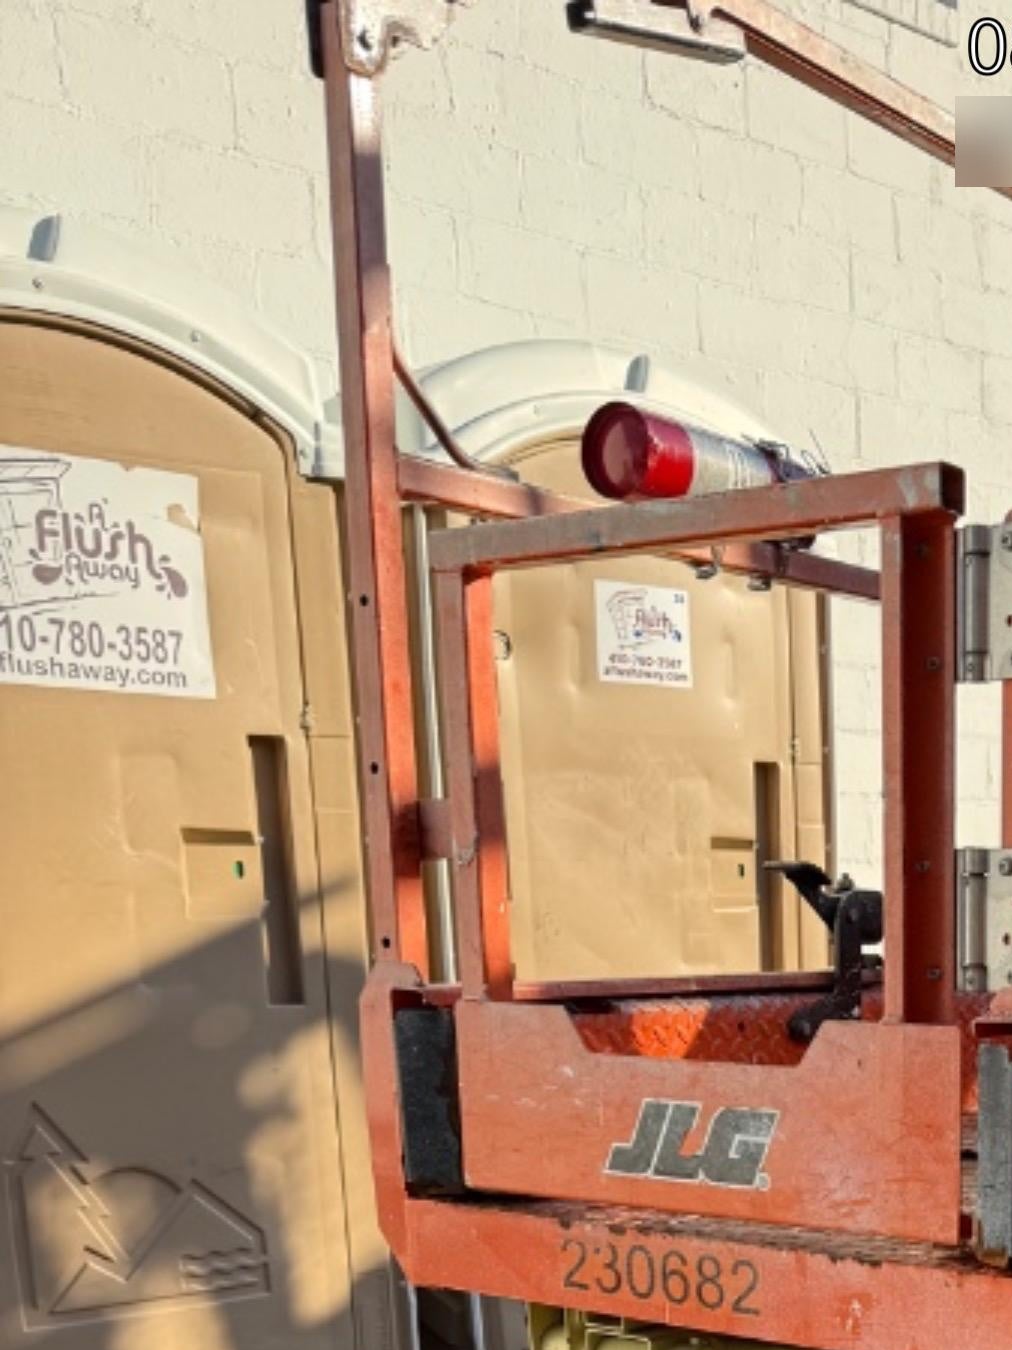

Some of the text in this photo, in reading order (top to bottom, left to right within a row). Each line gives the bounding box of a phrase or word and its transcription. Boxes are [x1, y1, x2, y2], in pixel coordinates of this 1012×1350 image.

[35, 509, 162, 580] Flush
[65, 552, 140, 588] Away
[602, 1097, 781, 1190] JLG
[561, 1239, 760, 1316] 230682
